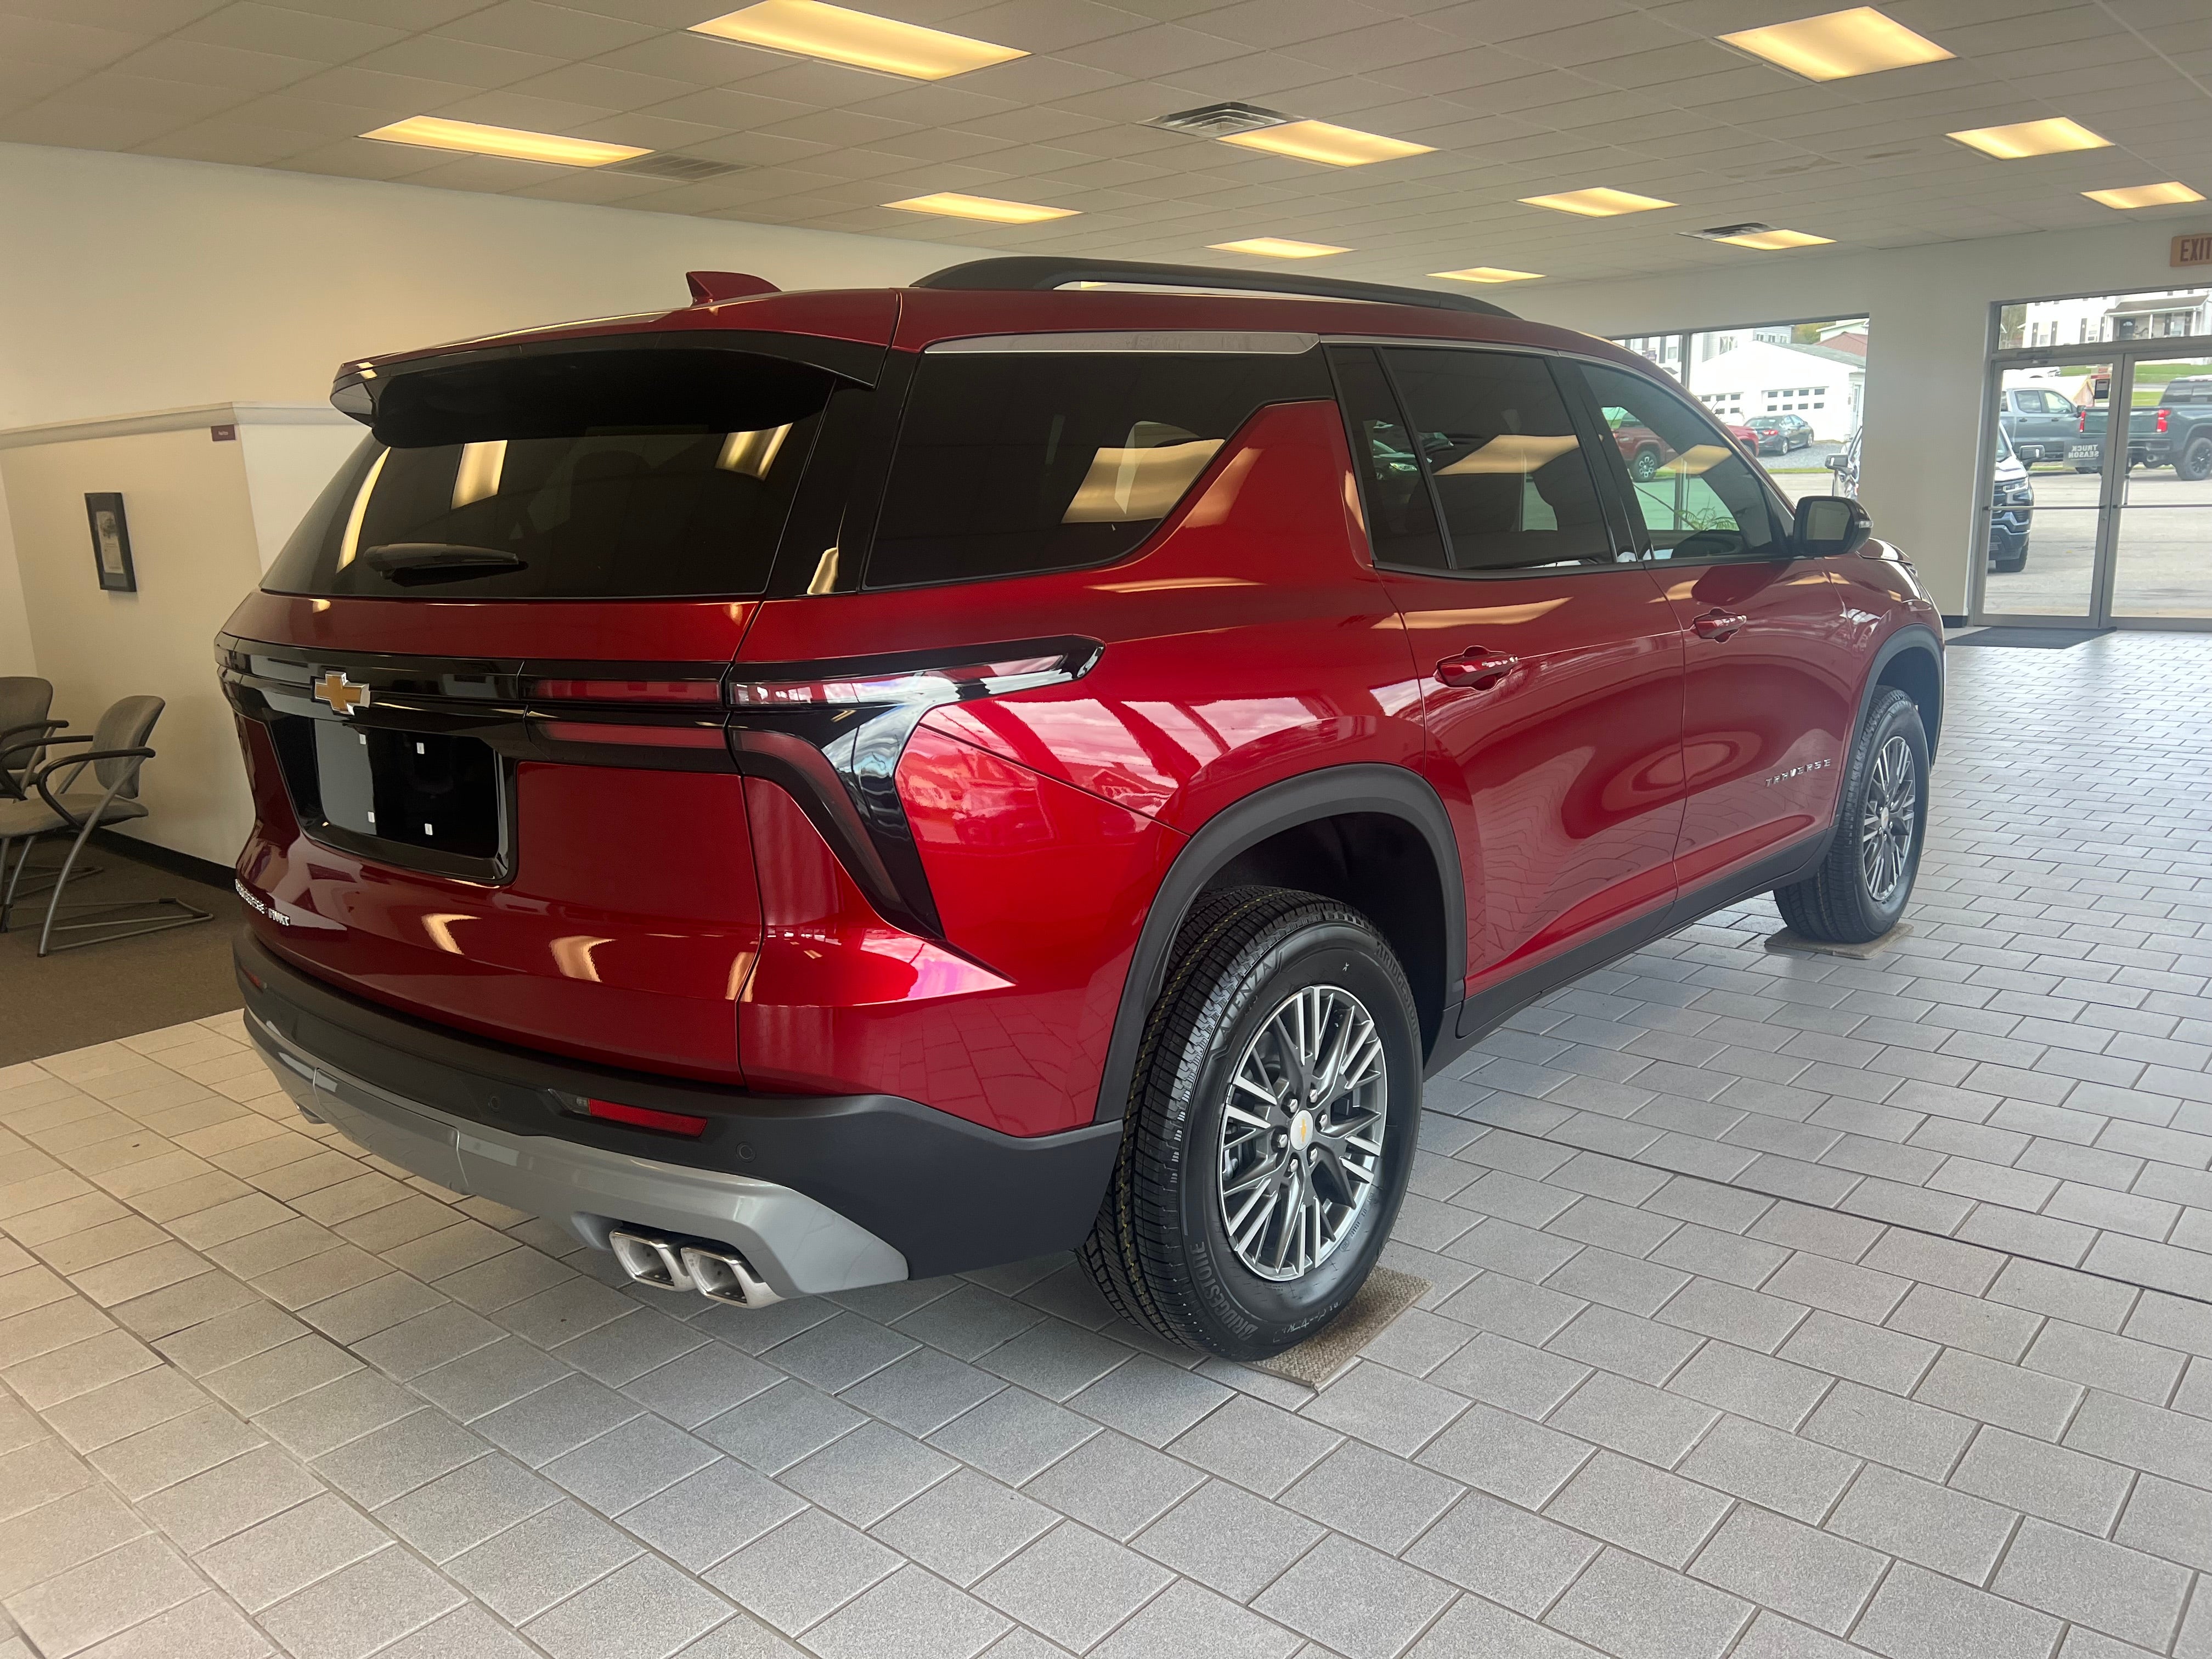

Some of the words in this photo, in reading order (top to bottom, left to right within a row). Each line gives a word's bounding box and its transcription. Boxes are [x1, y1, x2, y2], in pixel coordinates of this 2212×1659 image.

[2180, 237, 2212, 262] EXIT
[1765, 758, 1831, 787] TRAVERSE
[1220, 960, 1272, 1041] ALENZA
[1189, 1241, 1259, 1342] BRIDGESTONE
